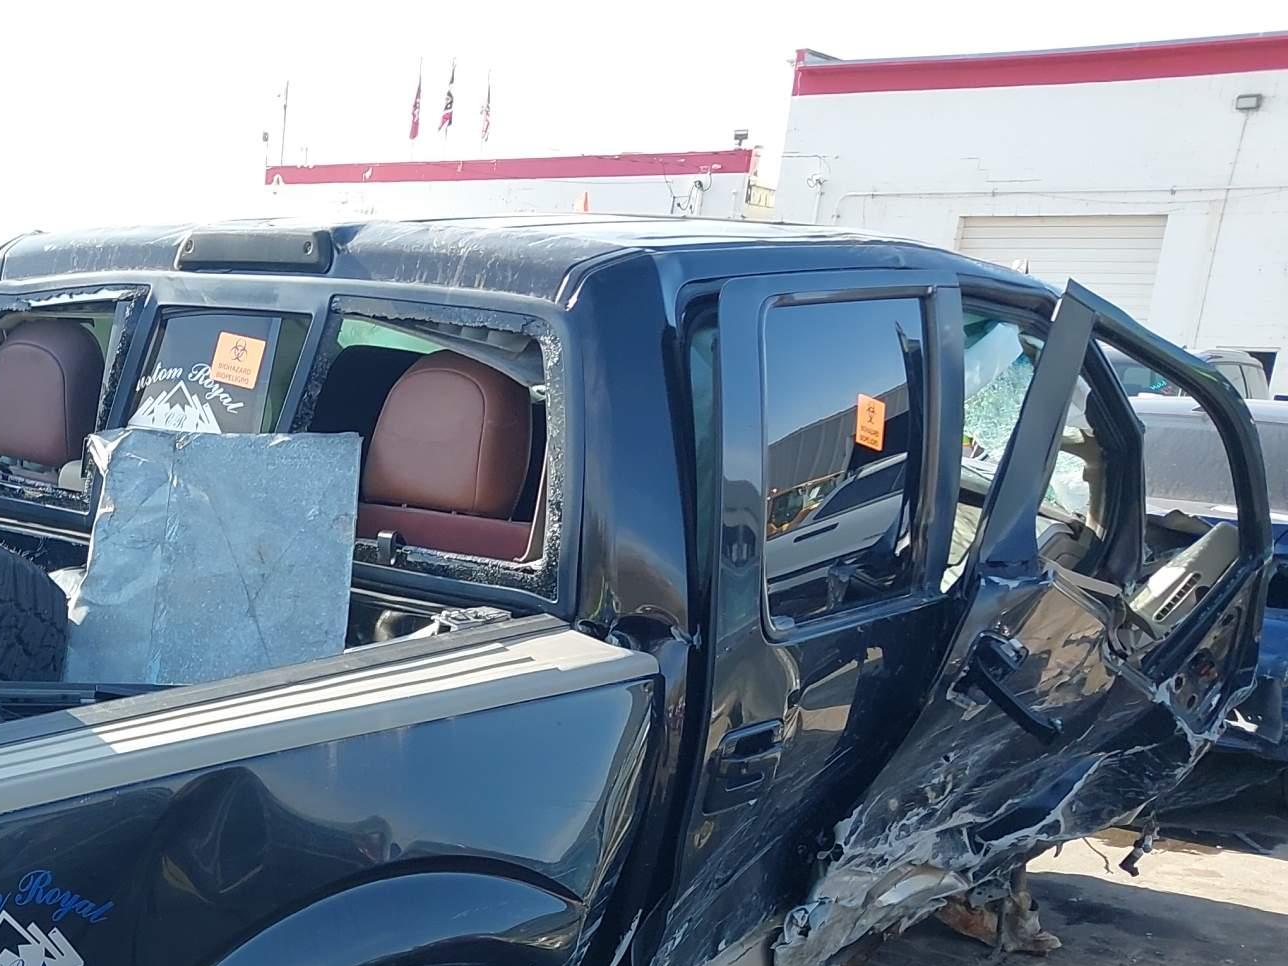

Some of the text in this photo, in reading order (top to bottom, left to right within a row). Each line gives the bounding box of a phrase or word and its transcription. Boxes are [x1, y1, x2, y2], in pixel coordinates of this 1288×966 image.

[135, 361, 245, 414] ustom Royal
[15, 869, 114, 924] Royal
